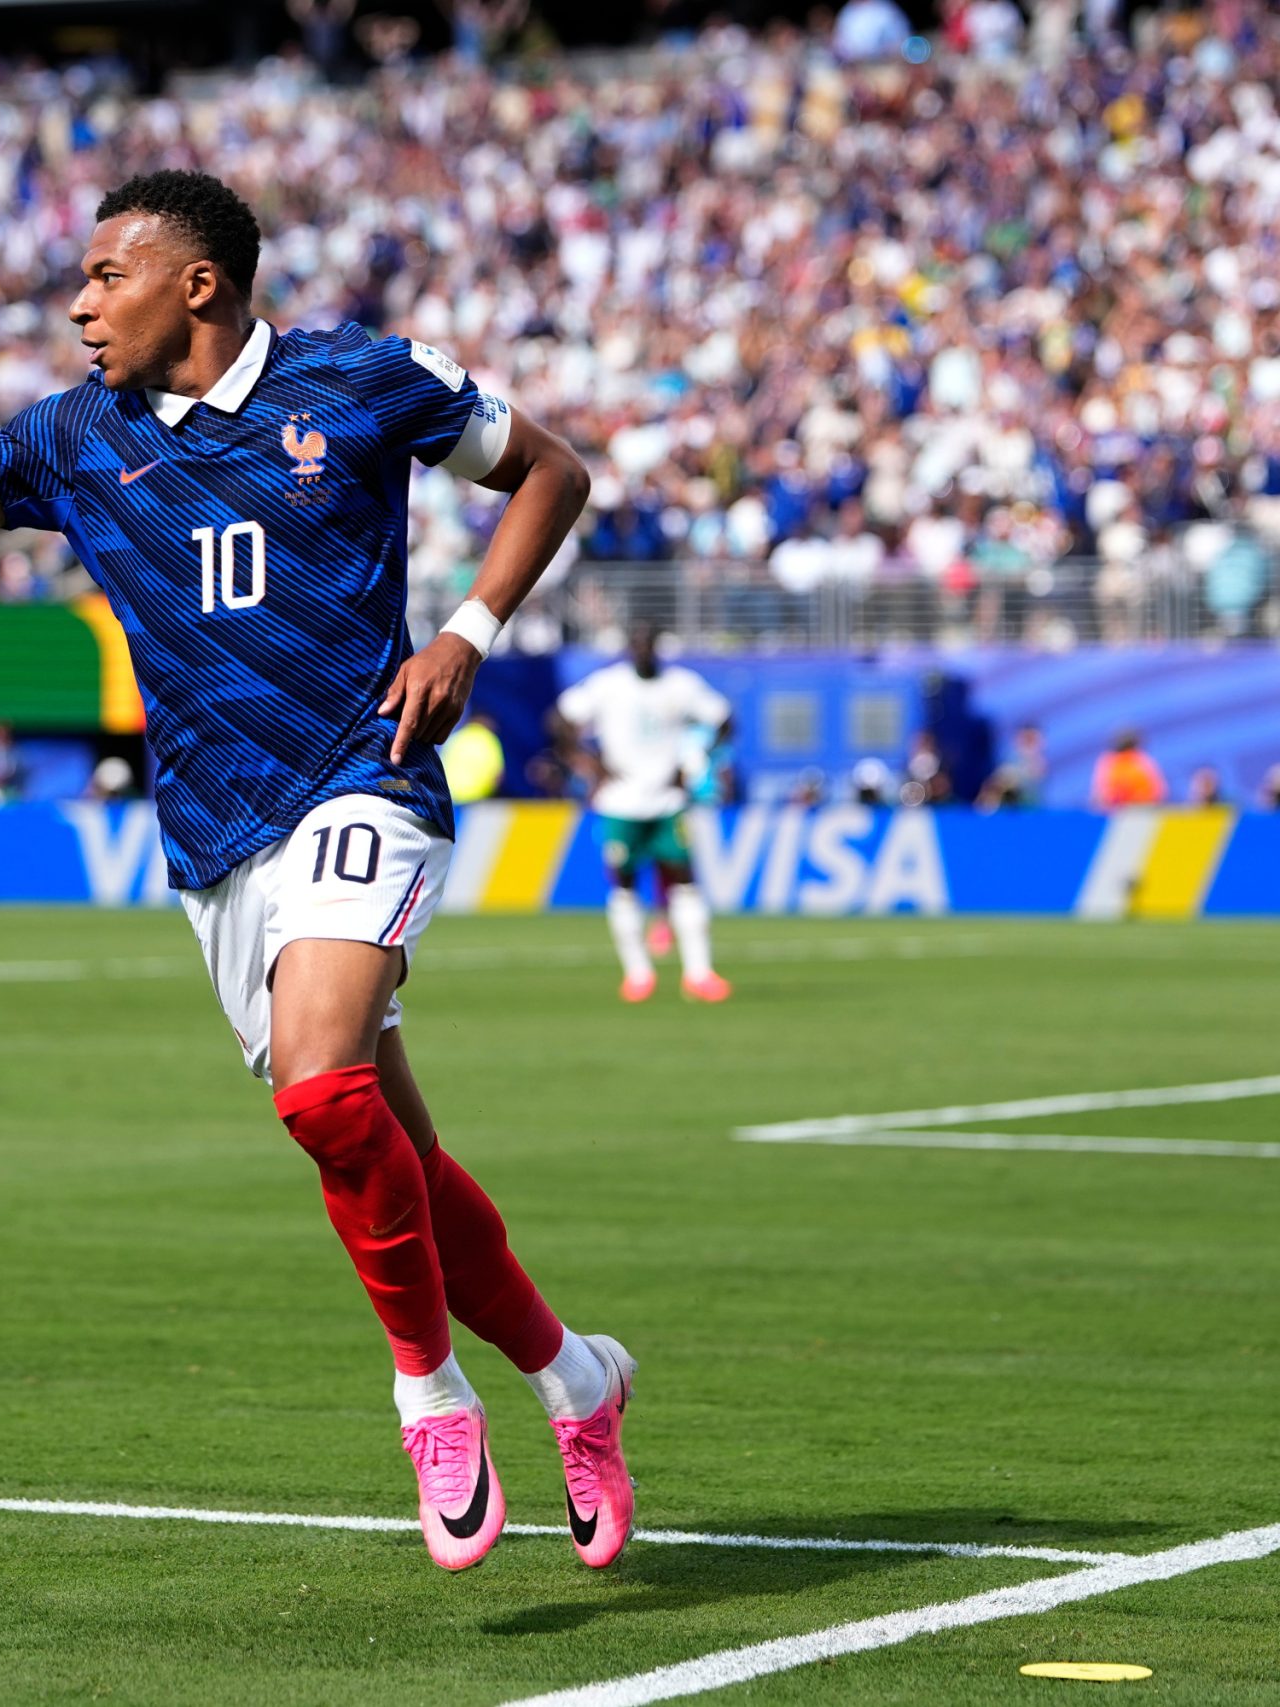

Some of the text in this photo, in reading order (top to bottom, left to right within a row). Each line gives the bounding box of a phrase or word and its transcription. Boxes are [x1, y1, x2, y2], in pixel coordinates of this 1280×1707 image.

[192, 520, 266, 613] 10
[312, 822, 381, 885] 10
[687, 803, 951, 914] VISA
